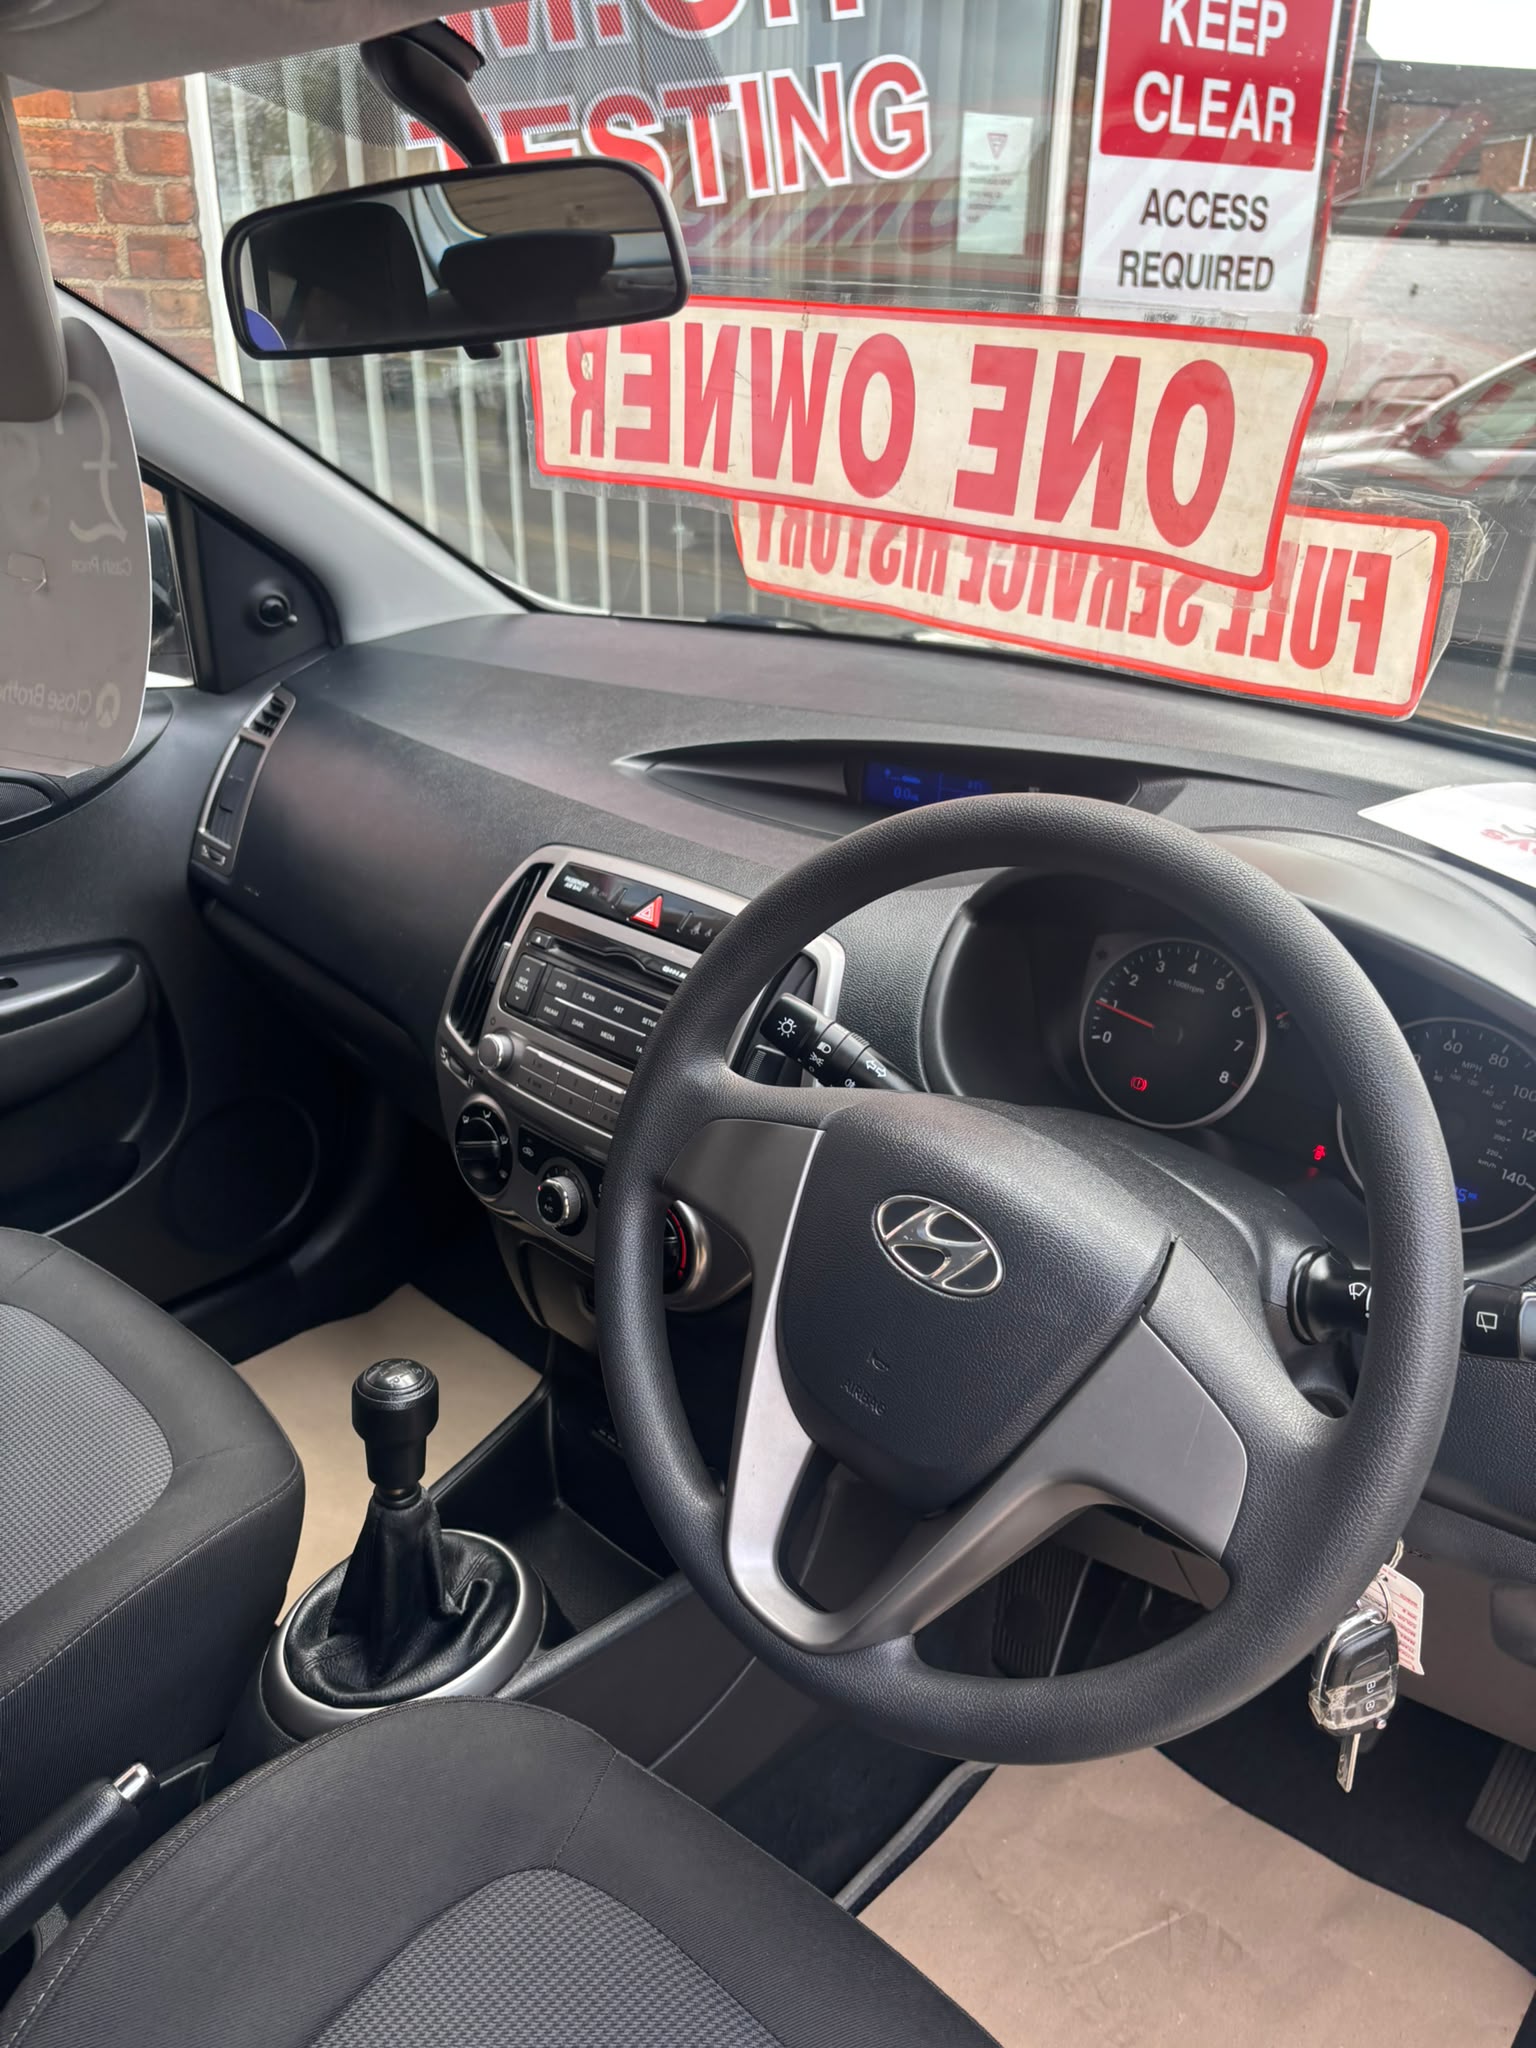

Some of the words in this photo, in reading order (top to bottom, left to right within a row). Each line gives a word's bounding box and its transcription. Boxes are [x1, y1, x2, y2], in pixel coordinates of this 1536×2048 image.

[1160, 0, 1288, 57] KEEP
[1133, 70, 1295, 146] CLEAR
[1140, 187, 1269, 232] ACCESS
[1118, 249, 1274, 293] REQUIRED
[1155, 961, 1165, 973] 3
[1188, 962, 1198, 974] 4
[1129, 973, 1139, 987] 2
[1215, 977, 1225, 991] 5
[581, 991, 596, 1002] SCAN
[1231, 1006, 1241, 1018] 6
[1102, 1031, 1112, 1043] 0
[1233, 1039, 1244, 1052] 7
[1443, 1040, 1463, 1054] 60
[1461, 1060, 1483, 1073] MPH
[1488, 1053, 1509, 1068] 80
[1218, 1071, 1229, 1084] 8
[1477, 1158, 1497, 1169] km/h
[1502, 1168, 1528, 1187] 140
